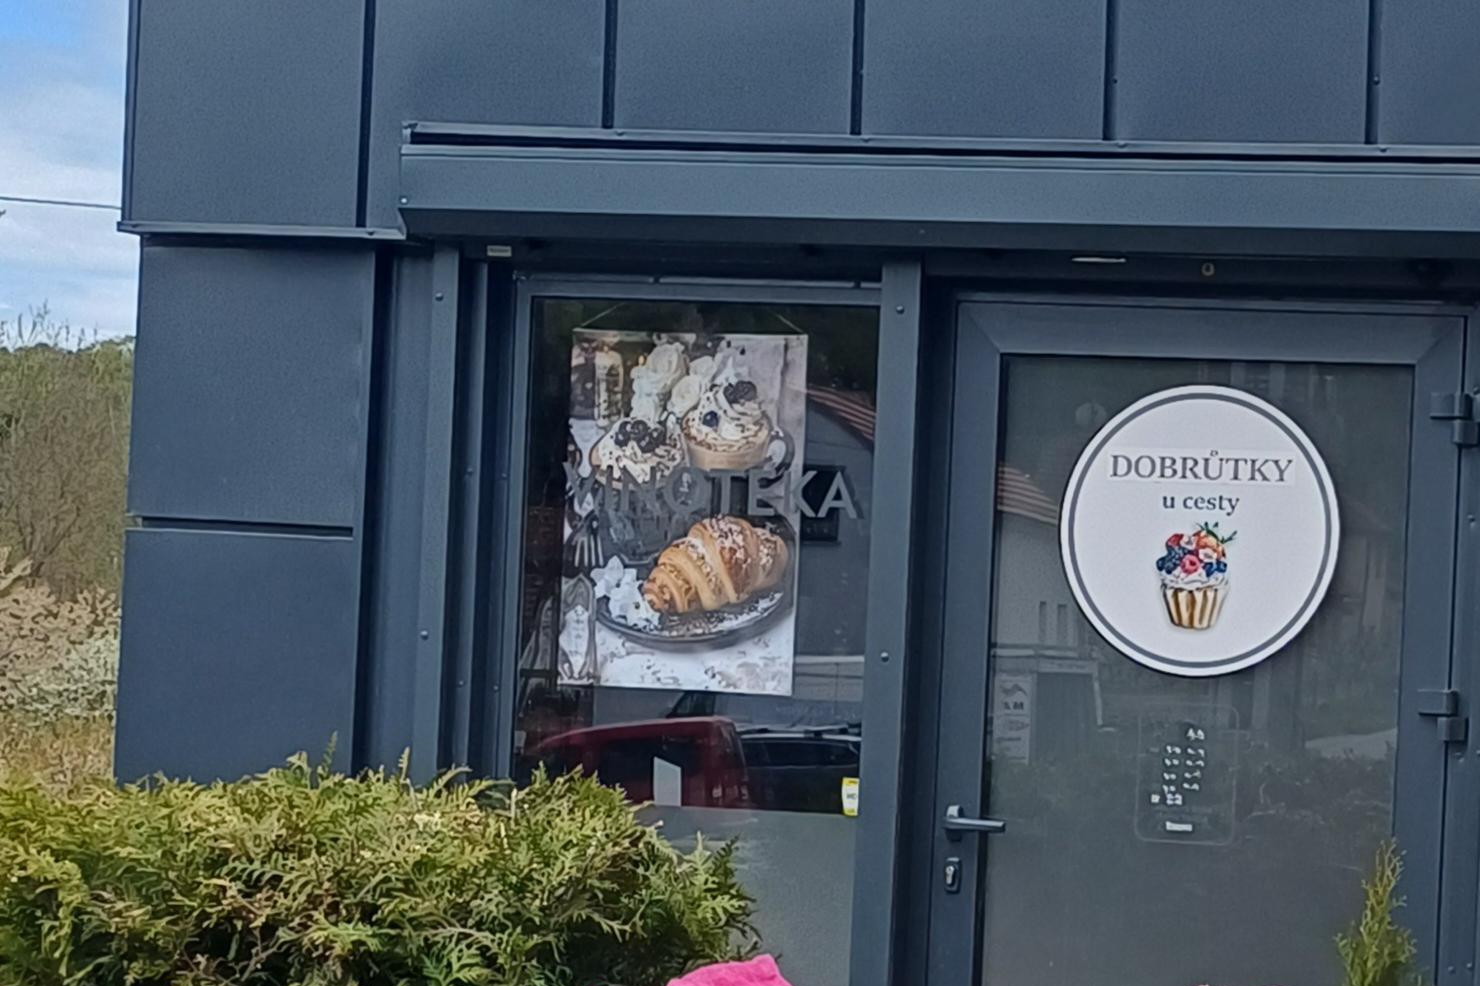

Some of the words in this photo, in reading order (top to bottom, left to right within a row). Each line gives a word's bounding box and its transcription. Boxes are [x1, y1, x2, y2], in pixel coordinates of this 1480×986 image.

[1110, 450, 1293, 482] DOBRŮTKY
[562, 461, 858, 519] VINOTEKA
[1162, 495, 1175, 509] u
[1182, 494, 1240, 516] cesty
